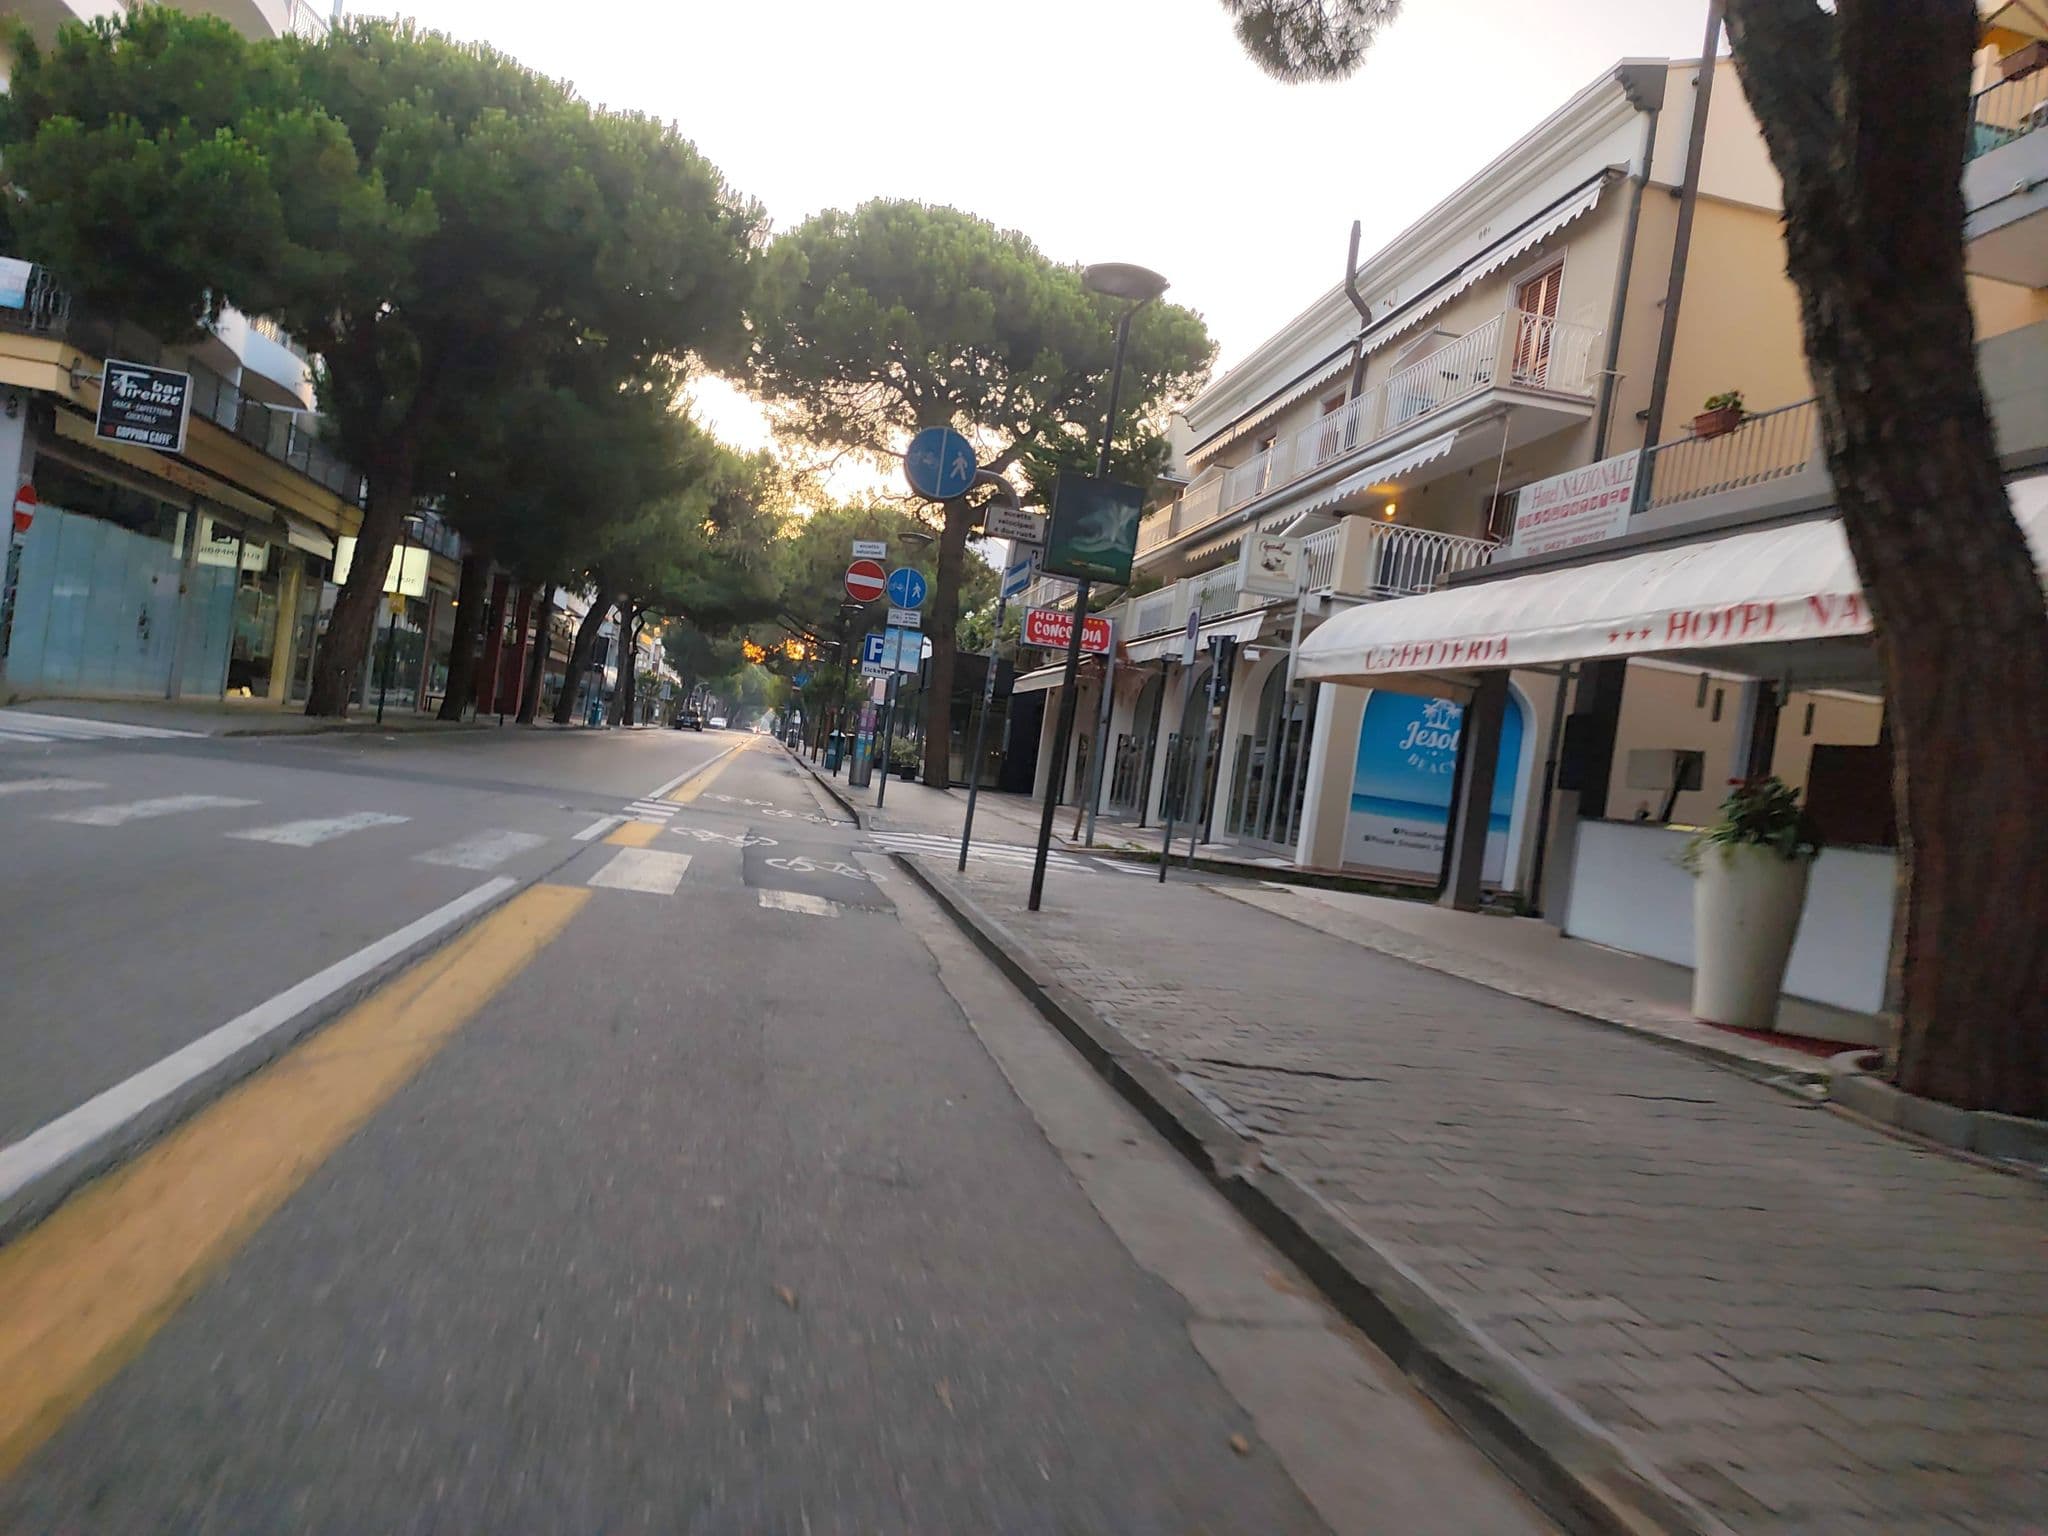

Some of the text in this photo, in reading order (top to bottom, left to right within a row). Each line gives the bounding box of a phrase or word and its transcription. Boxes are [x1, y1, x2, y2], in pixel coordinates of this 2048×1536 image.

[152, 380, 183, 395] bar
[1558, 455, 1638, 500] NAZIONALE
[1035, 611, 1074, 624] HOTE
[1666, 602, 1787, 642] HOTEL
[1034, 621, 1102, 643] CONCODIA
[1400, 721, 1461, 751] Jesol
[1407, 753, 1459, 774] BEAC
